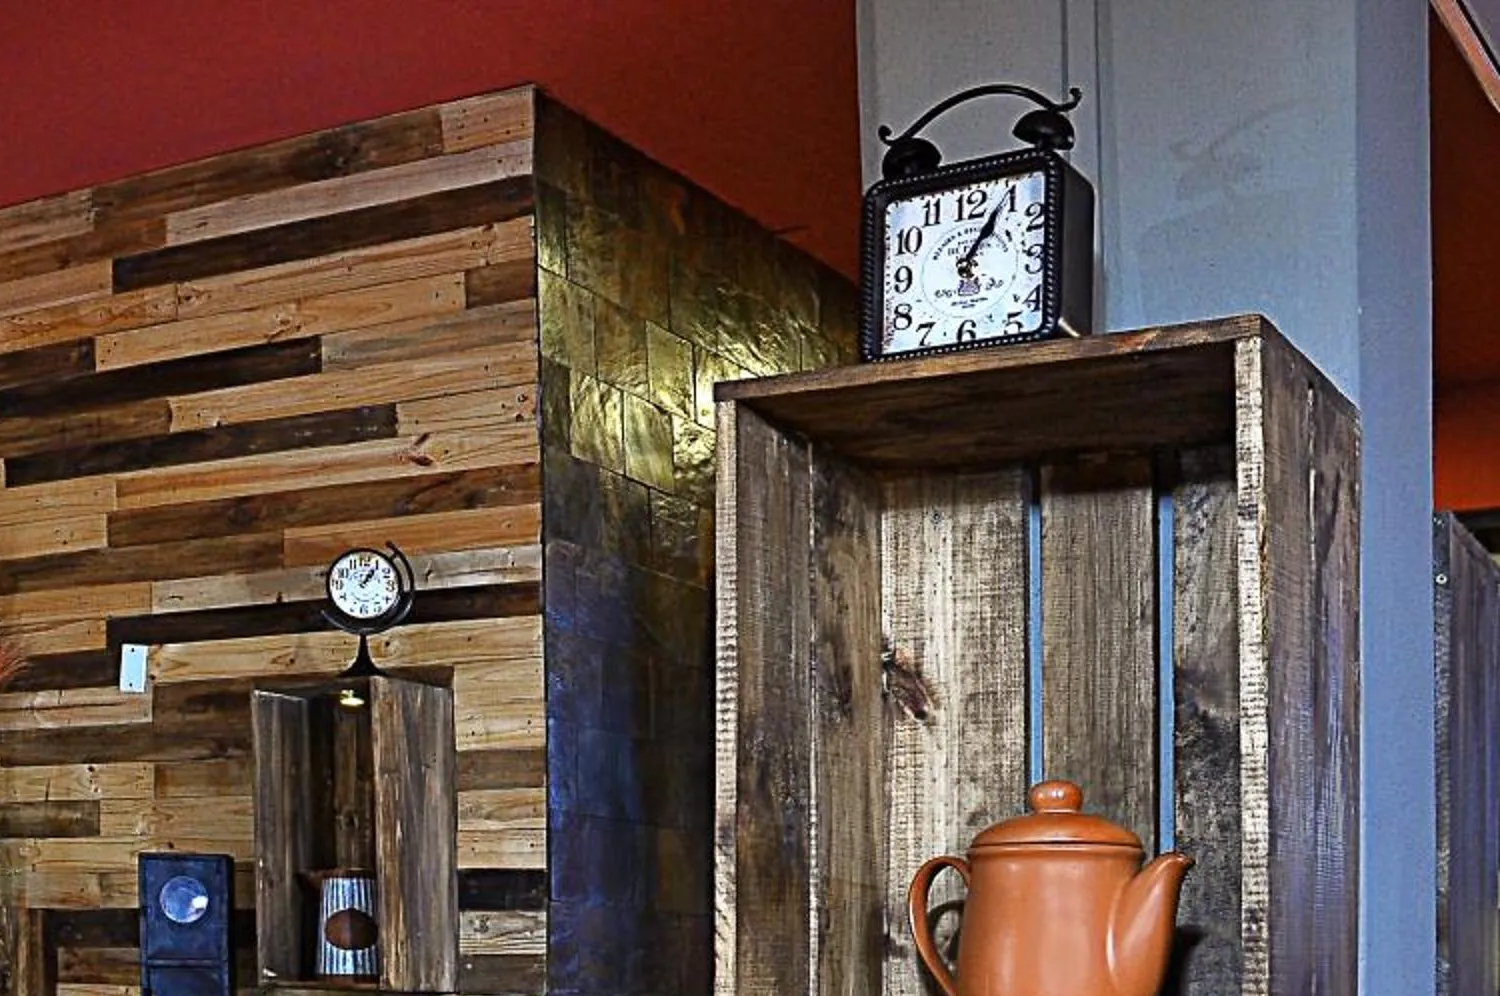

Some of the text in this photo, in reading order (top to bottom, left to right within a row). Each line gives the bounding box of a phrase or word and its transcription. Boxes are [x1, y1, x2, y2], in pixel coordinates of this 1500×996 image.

[923, 199, 941, 227] 11
[954, 189, 987, 223] 12
[1007, 184, 1018, 213] 1
[1024, 202, 1045, 232] 2
[895, 225, 923, 256] 10
[1025, 243, 1045, 275] 3
[894, 265, 913, 294] 9
[1022, 284, 1042, 313] 4
[893, 303, 913, 330] 8
[915, 322, 936, 347] 7
[957, 320, 977, 344] 6
